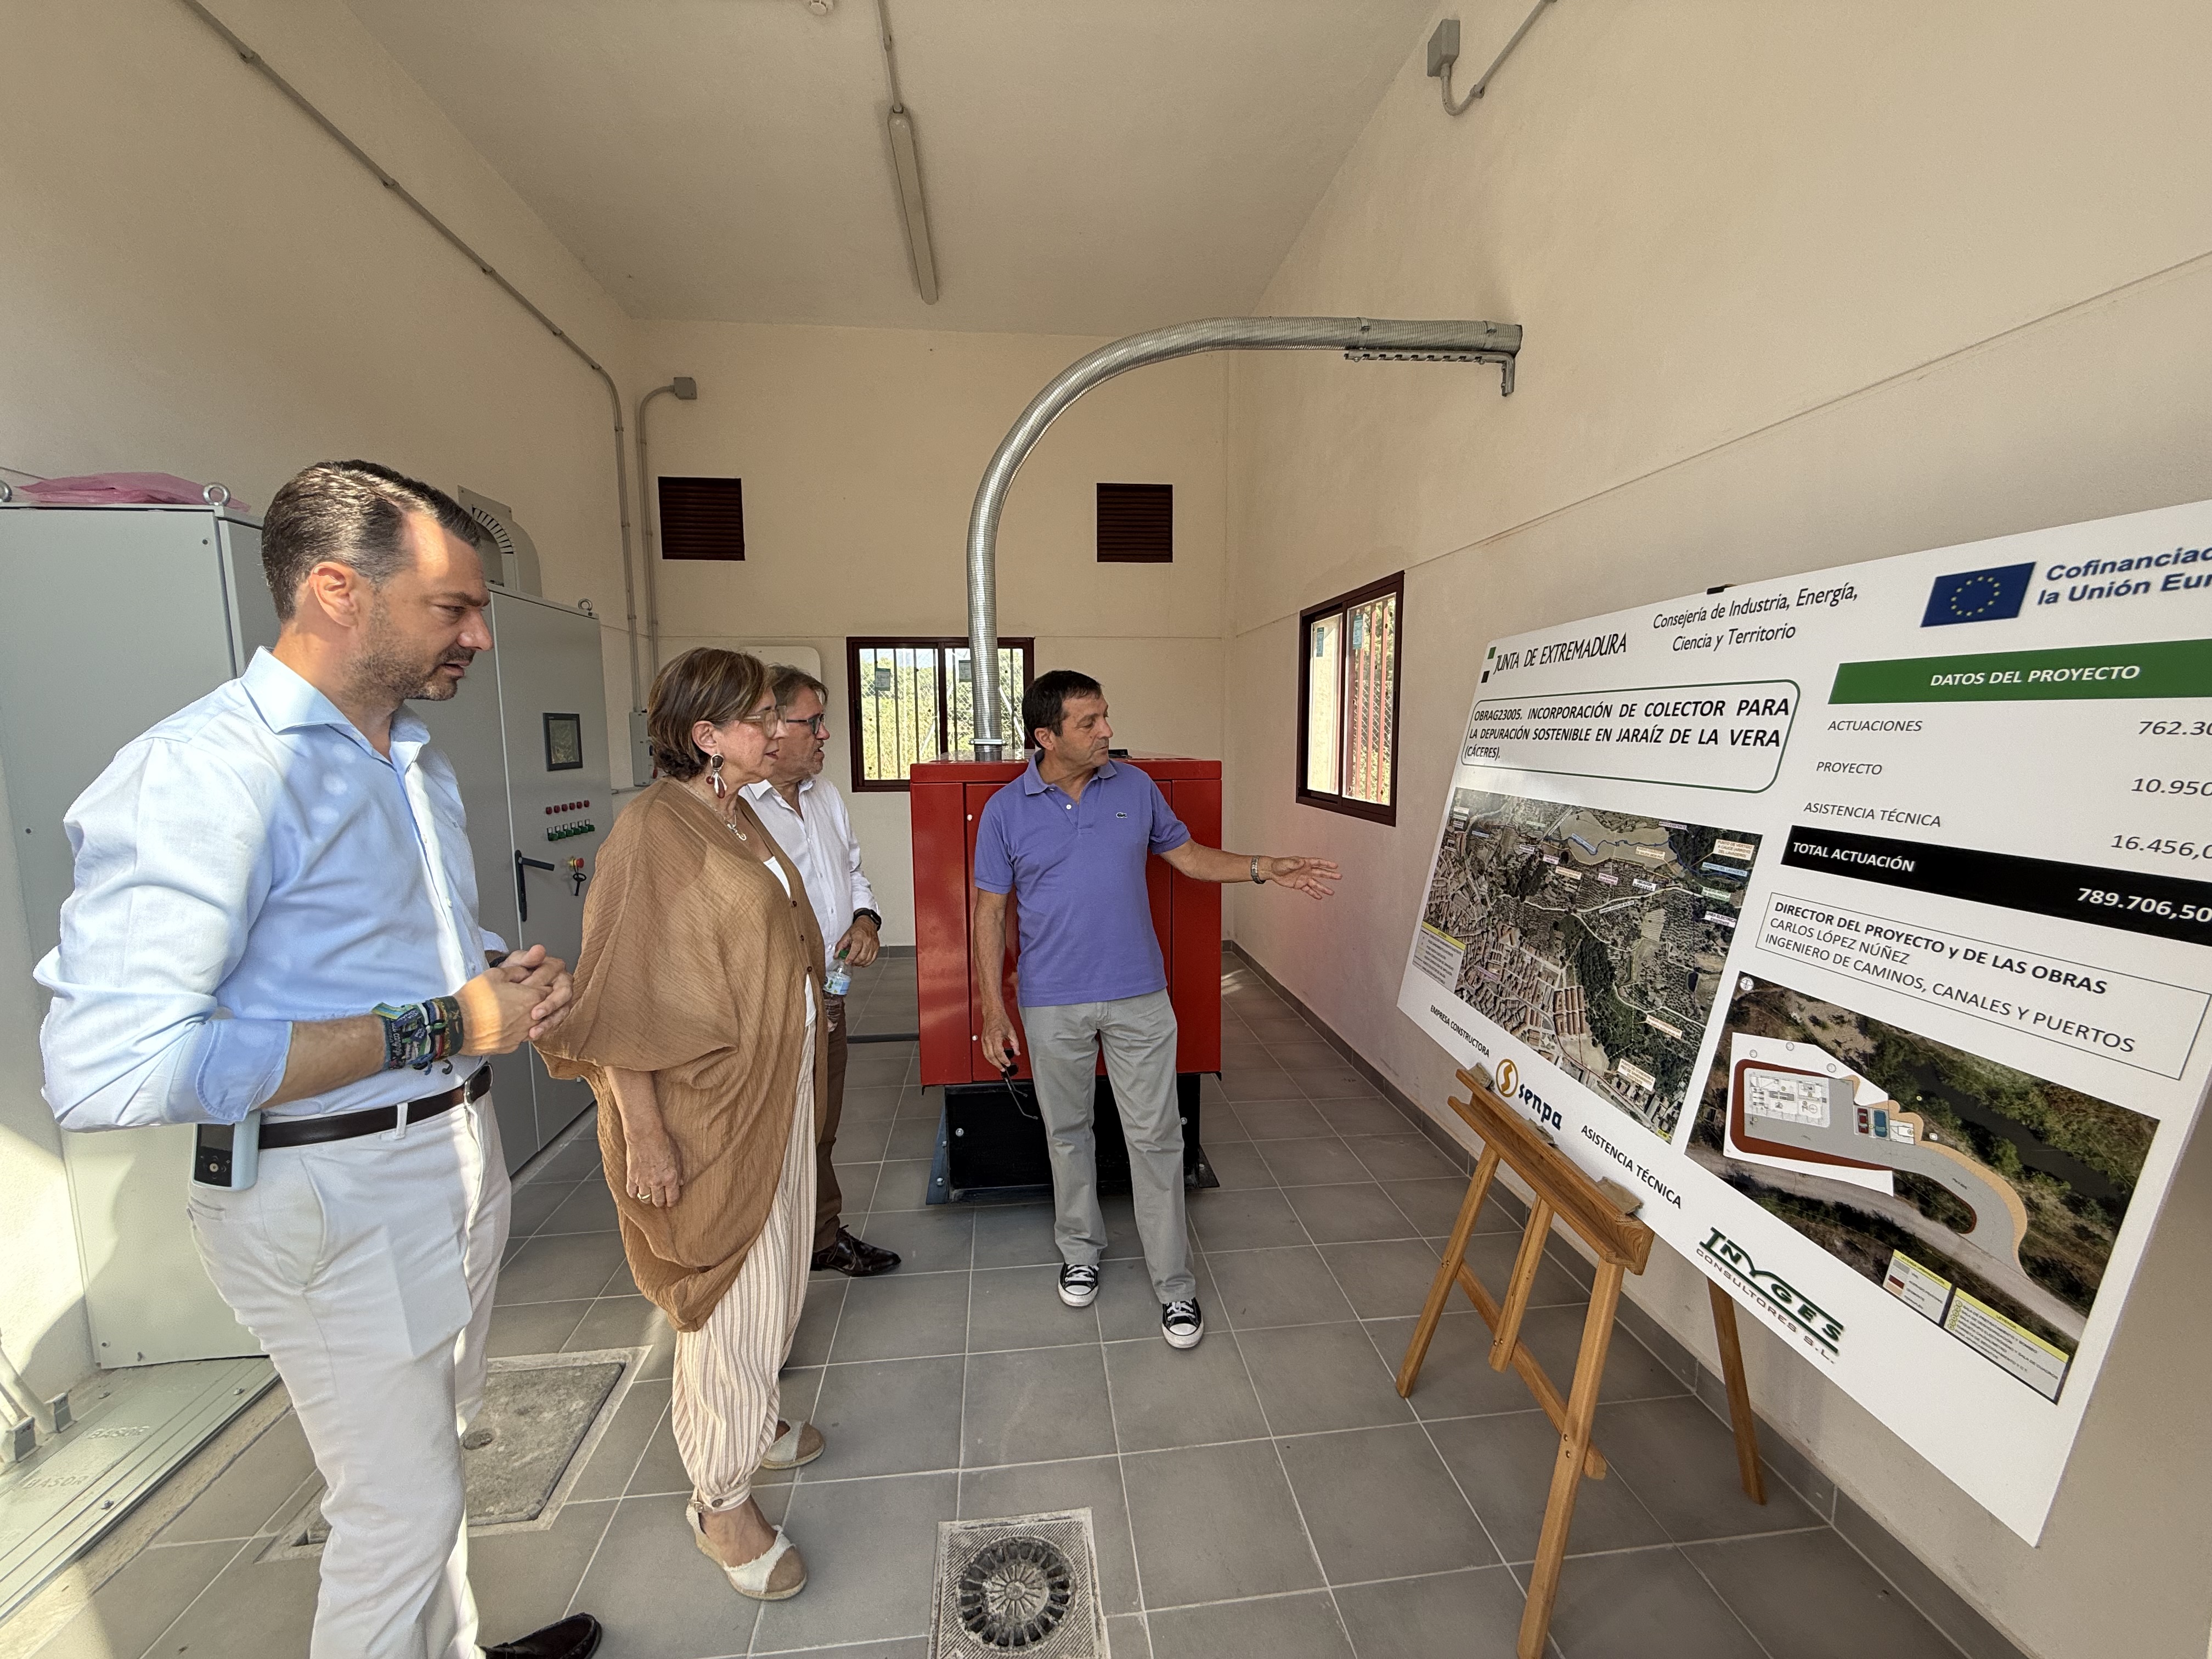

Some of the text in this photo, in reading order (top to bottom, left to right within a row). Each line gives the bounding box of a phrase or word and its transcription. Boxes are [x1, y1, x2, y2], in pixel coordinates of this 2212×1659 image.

[1652, 583, 1858, 629] Consejería de Industria, Energía,
[2037, 590, 2059, 605] la
[2068, 579, 2151, 601] Unión
[1493, 633, 1627, 674] JUNTA DE EXTREMADURA
[1673, 624, 1796, 652] Ciencia y Territorio
[1929, 665, 2141, 687] DATOS DEL PROYECTO
[1527, 701, 1613, 720] INCORPORACIÓN
[1619, 702, 1635, 718] DE
[1645, 700, 1724, 718] COLECTOR
[1736, 698, 1790, 716] PARA
[1469, 724, 1781, 748] LA DEPURACIÓN SOSTENIBLE EN JARAÍZ DE LA VERA
[1827, 720, 1922, 732] ACTUACIONES
[1464, 744, 1501, 760] (CÁCERES).
[1815, 761, 1883, 776] PROYECTO
[2131, 778, 2212, 796] 10.950
[1803, 802, 1942, 828] ASISTENCIA TÉCNICA
[1792, 841, 1915, 872] TOTAL ACTUACIÓN
[2077, 888, 2212, 922] 789.706,50
[1770, 918, 1910, 965] CARLOS LÓPEZ NÚÑEZ
[1775, 901, 2108, 995] DIRECTOR DEL PROYECTO y DE LAS OBRAS
[1765, 933, 2135, 1053] INGENIERO DE CAMINOS, CANALES Y PUERTOS
[1430, 1005, 1489, 1058] EMPRESA CONSTRUCTORA
[1519, 1084, 1562, 1131] senpa
[1581, 1125, 1681, 1209] ASISTENCIA TÉCNICA
[1696, 1248, 1836, 1364] CONSULTORES S.L.
